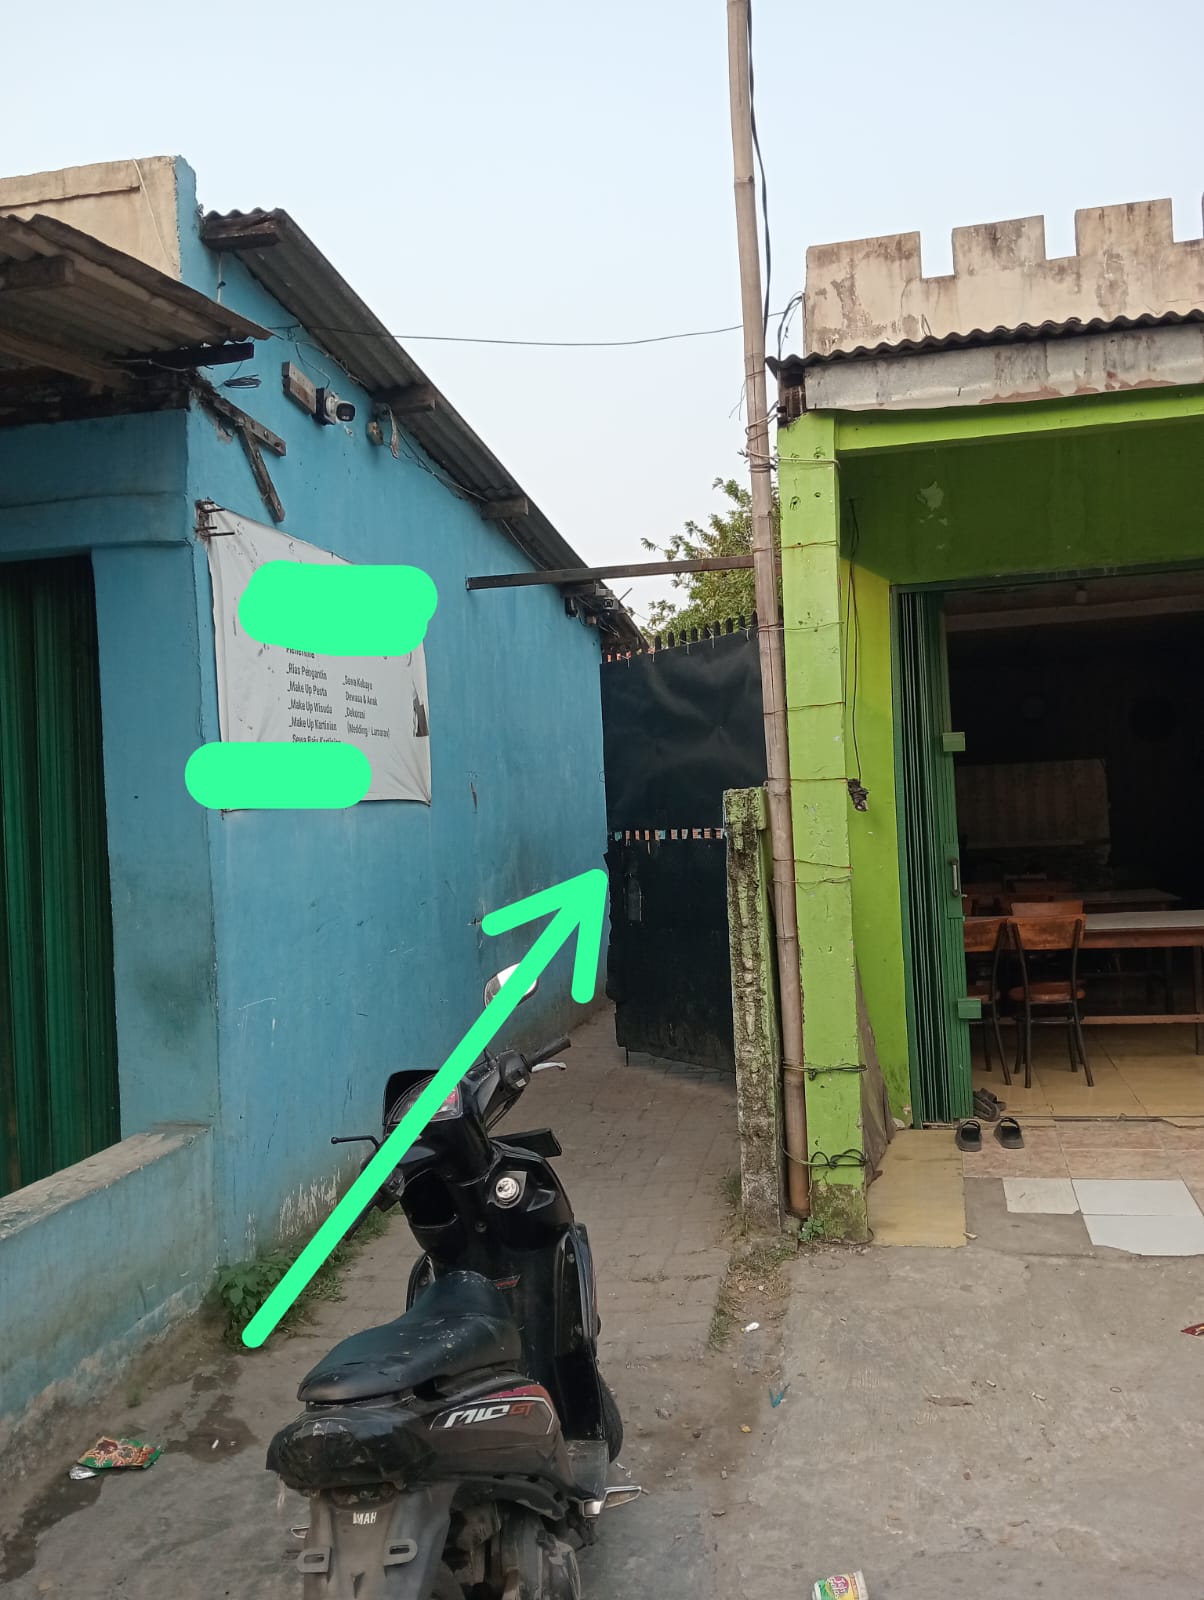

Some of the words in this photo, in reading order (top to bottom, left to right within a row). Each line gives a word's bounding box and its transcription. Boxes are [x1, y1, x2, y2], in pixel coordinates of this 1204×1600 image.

[301, 665, 328, 680] Pengantin
[304, 683, 312, 696] Up
[312, 684, 328, 697] Pesta
[305, 699, 314, 714] Up
[313, 702, 333, 714] Wisuda
[306, 717, 314, 731] Up
